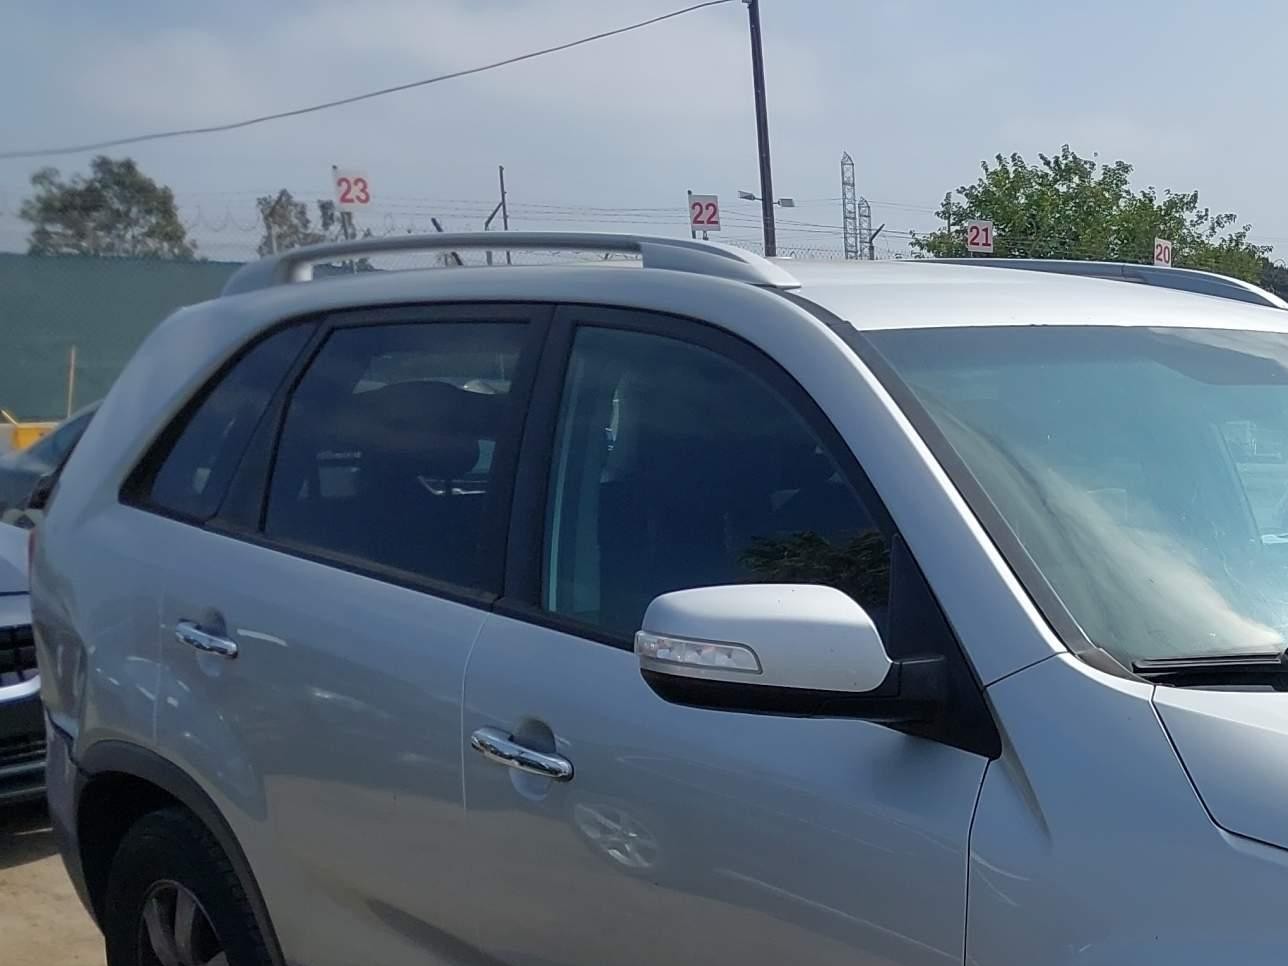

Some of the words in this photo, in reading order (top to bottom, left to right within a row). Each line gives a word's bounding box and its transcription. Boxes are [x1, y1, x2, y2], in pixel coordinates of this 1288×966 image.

[336, 177, 370, 204] 23
[691, 201, 719, 225] 22
[969, 225, 992, 247] 21
[1155, 243, 1170, 264] 20
